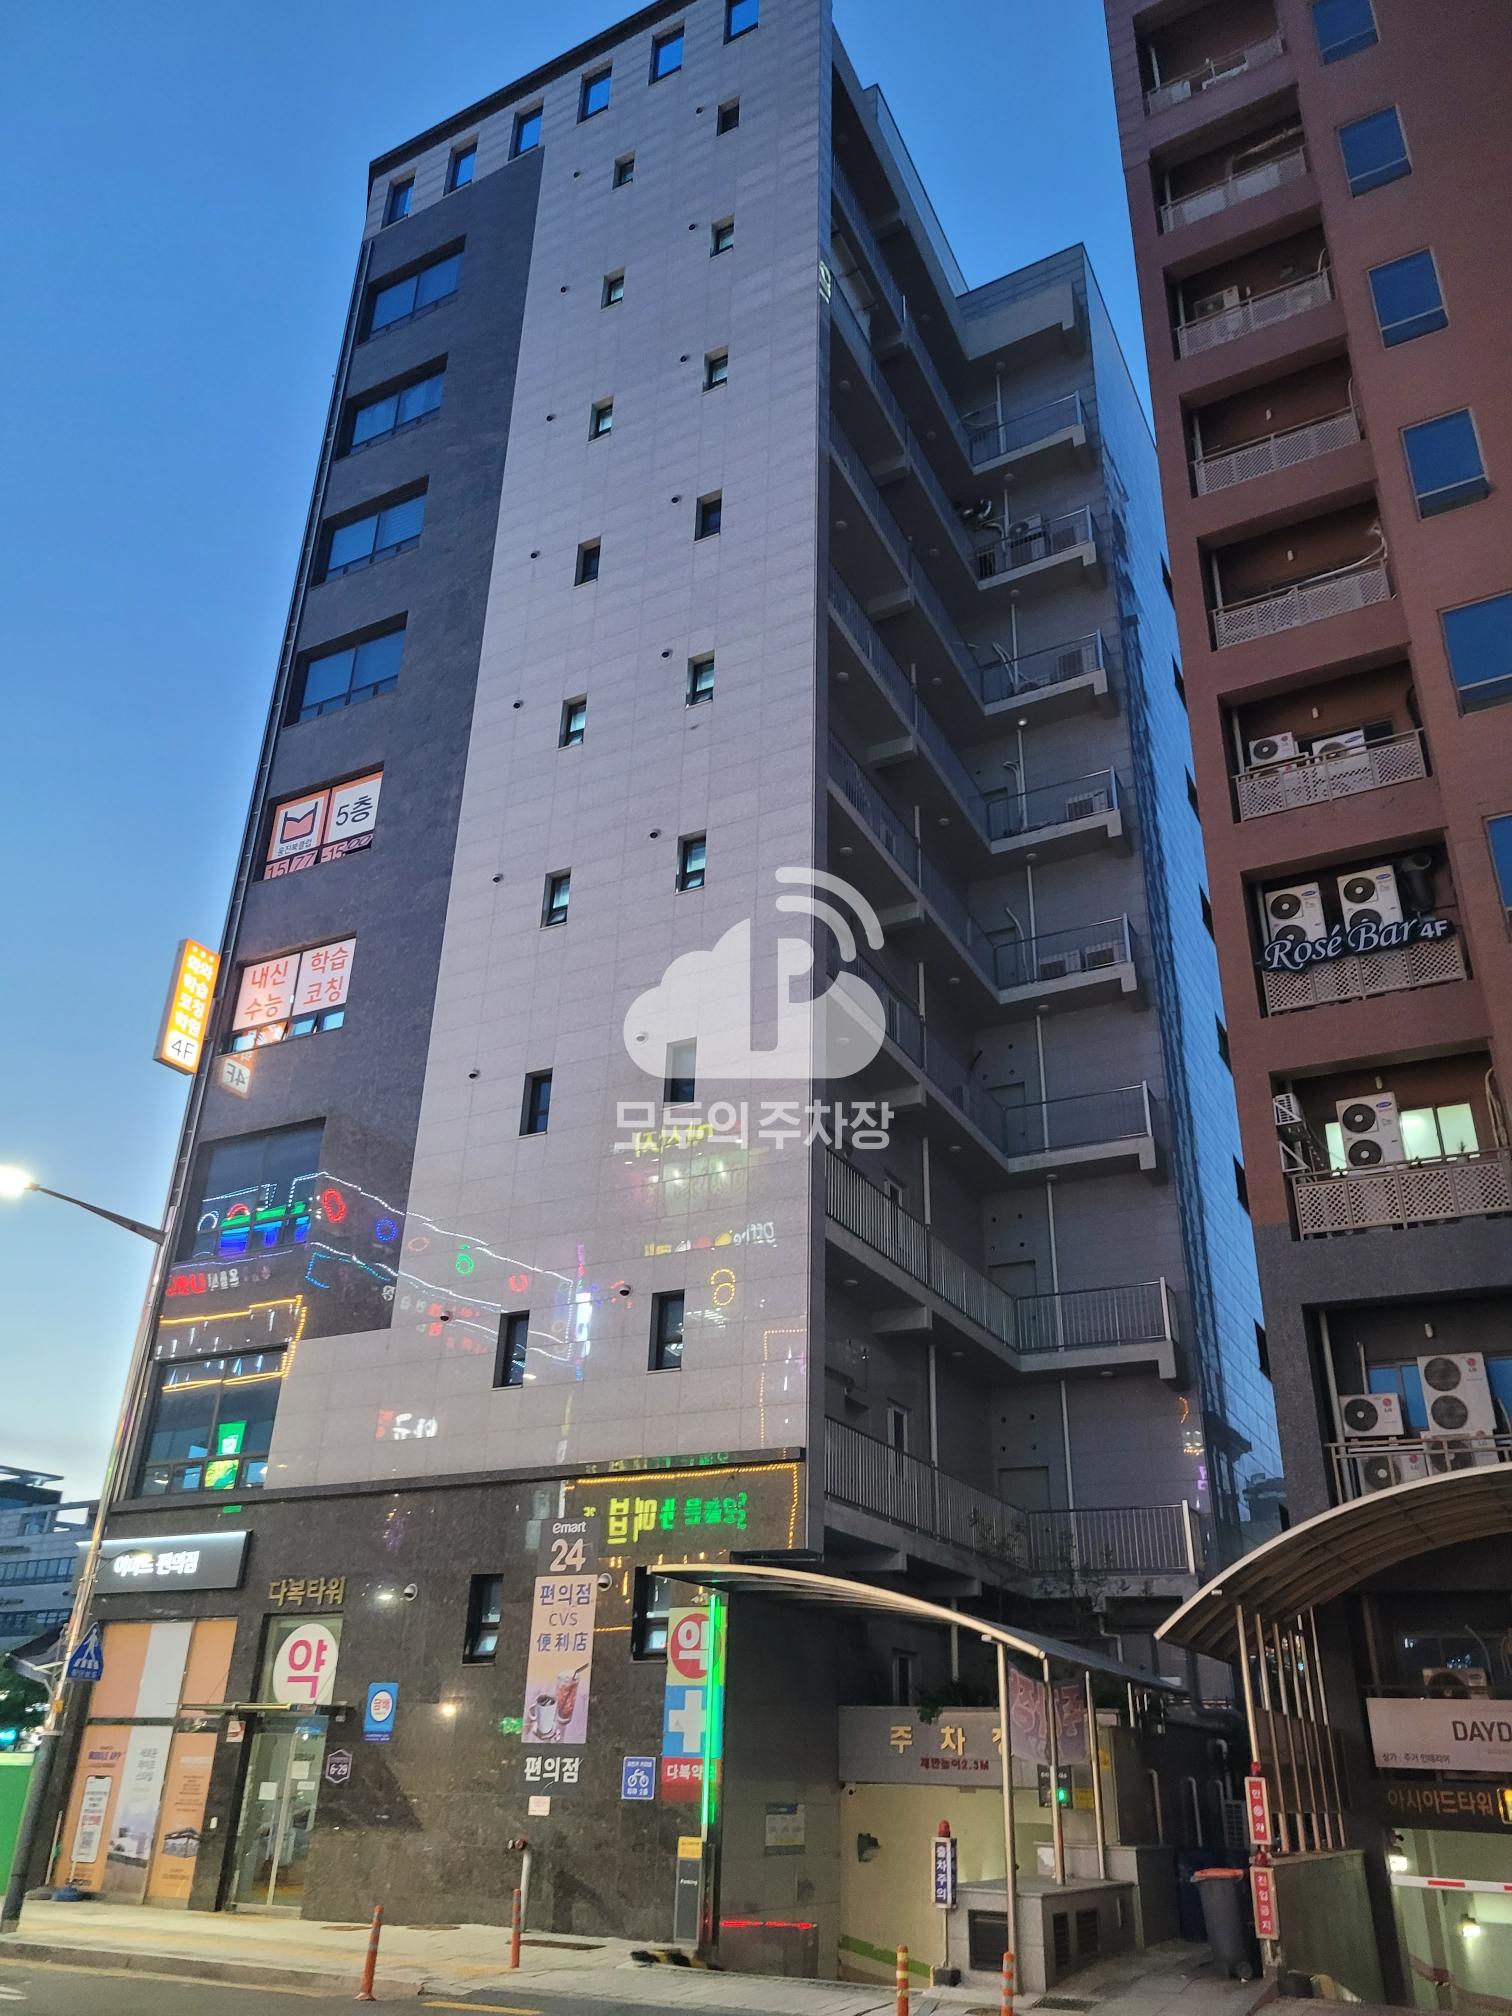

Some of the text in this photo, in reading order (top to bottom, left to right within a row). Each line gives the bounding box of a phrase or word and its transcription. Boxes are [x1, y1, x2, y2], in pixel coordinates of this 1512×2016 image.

[336, 794, 374, 827] 5층
[1264, 918, 1448, 970] Rosé Bar 4F
[251, 946, 349, 988] 내신 학습
[244, 975, 344, 1020] 수능 코칭
[171, 1039, 195, 1060] 4F
[552, 1520, 587, 1535] emart
[549, 1538, 587, 1572] 24
[268, 1576, 346, 1607] 다복타워
[539, 1582, 592, 1606] 편의점
[548, 1611, 579, 1627] CVS
[536, 1631, 589, 1653] 便利店
[287, 1639, 328, 1699] 약
[523, 1756, 580, 1783] 편의점
[1388, 1789, 1495, 1816] 아시아드타워
